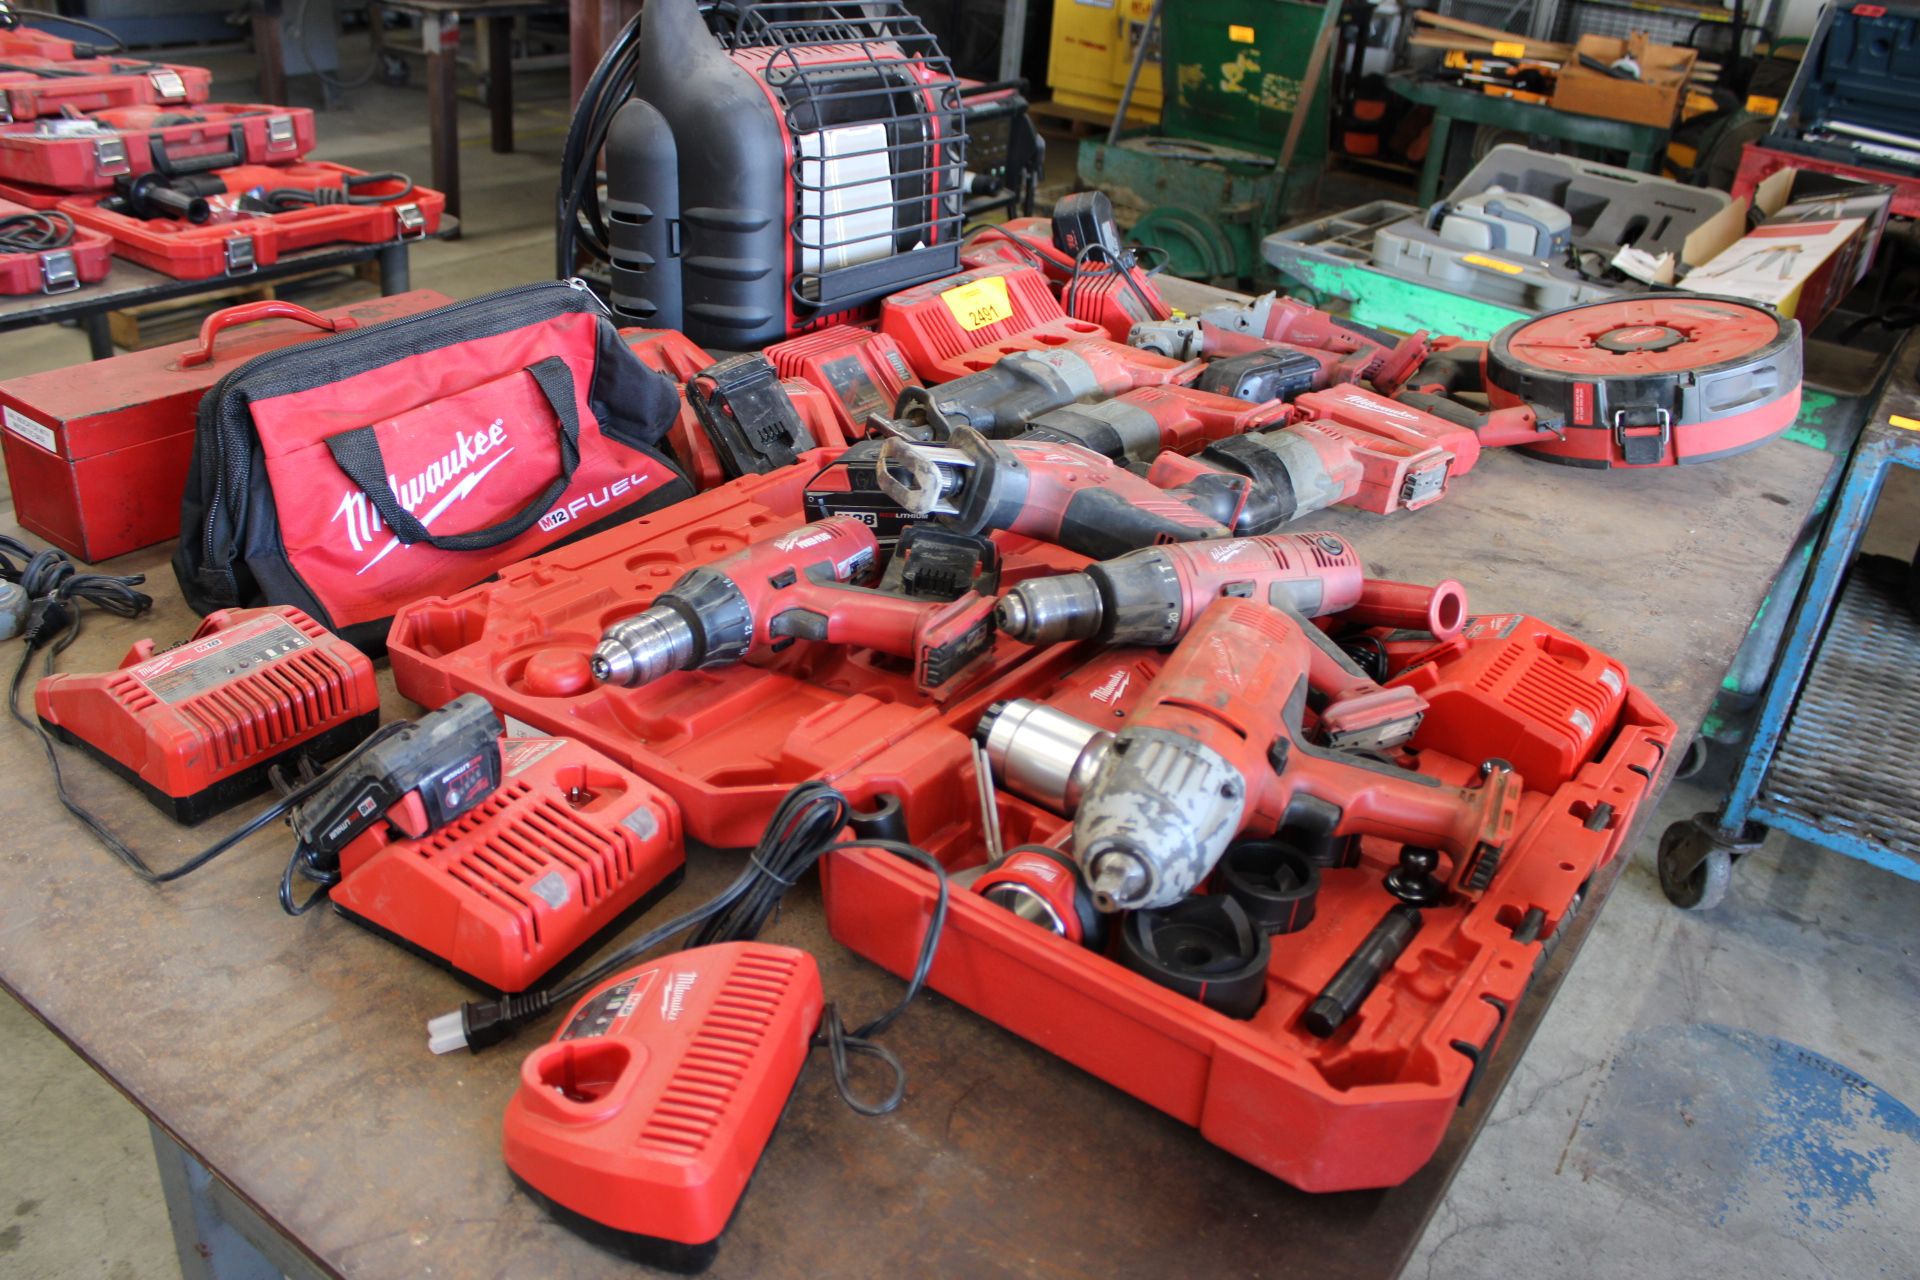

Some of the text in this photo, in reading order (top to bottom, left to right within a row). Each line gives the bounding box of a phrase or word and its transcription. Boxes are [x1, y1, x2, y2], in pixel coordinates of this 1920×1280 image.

[968, 303, 999, 327] 2491
[541, 474, 649, 530] M12 FUEL
[667, 971, 698, 1021] Milwaukee
